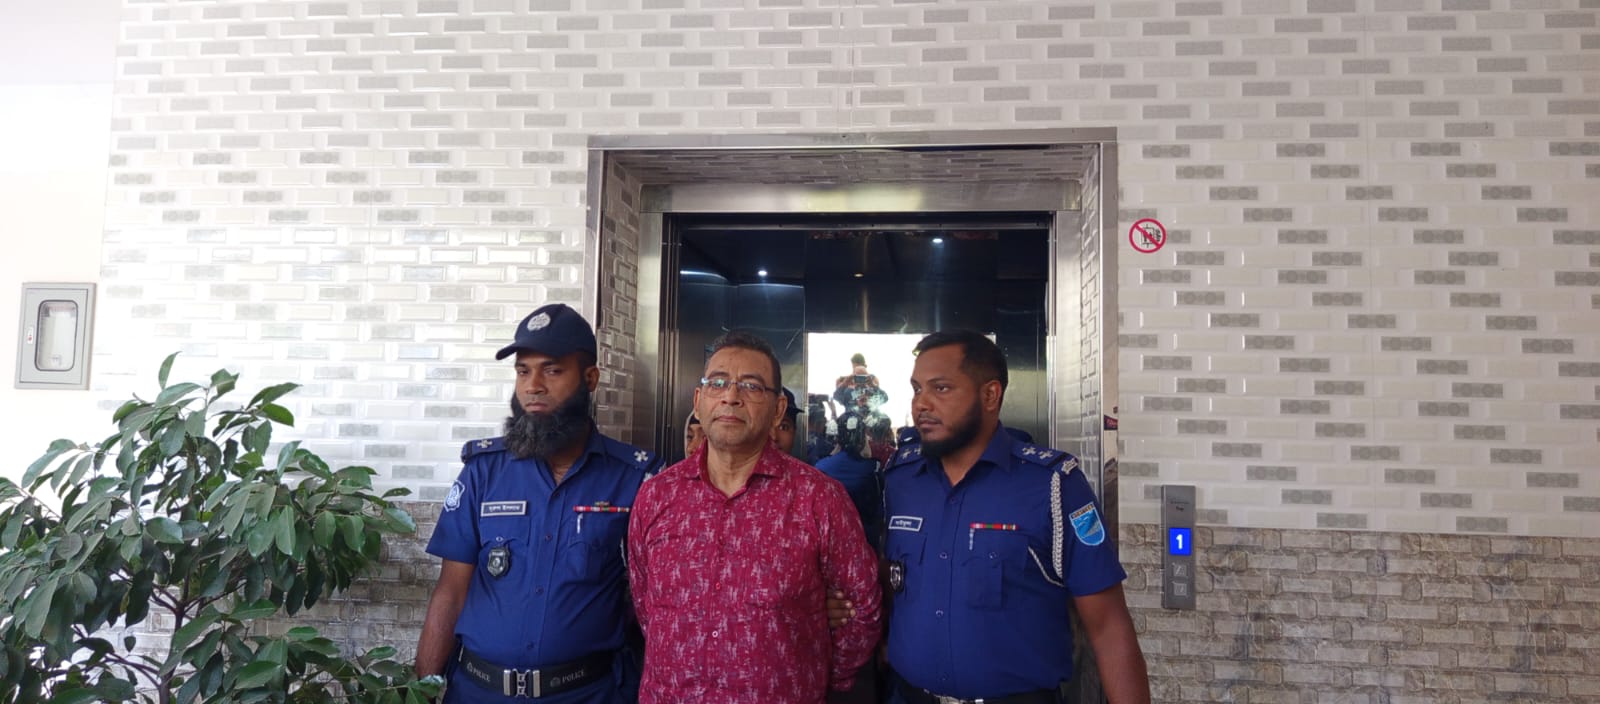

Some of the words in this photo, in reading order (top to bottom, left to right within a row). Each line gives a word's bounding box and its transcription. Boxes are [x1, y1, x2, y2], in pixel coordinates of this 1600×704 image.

[1175, 533, 1183, 550] 1
[473, 668, 490, 682] POLICE
[562, 669, 585, 683] POLICE
